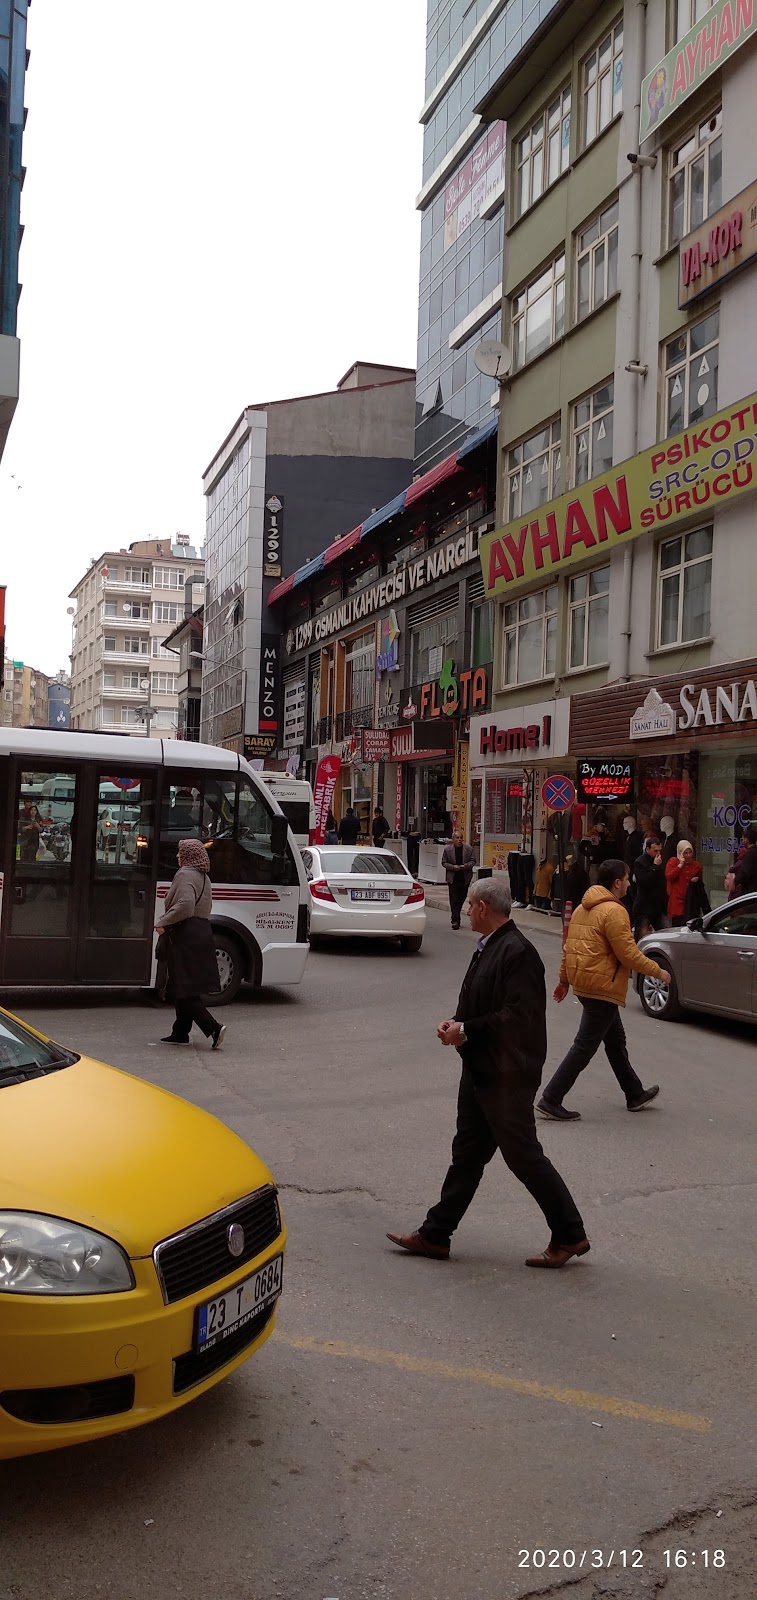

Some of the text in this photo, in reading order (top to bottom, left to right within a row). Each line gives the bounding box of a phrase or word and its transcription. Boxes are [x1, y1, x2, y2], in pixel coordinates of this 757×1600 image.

[670, 0, 754, 105] AYHAN
[681, 210, 743, 287] VA-KOR
[651, 402, 757, 475] PSİKOT
[649, 436, 757, 500] SRC-OD
[640, 459, 754, 528] SÜRÜCÜ
[267, 515, 280, 563] 1299
[487, 474, 632, 590] AYHAN
[294, 620, 313, 653] 1299
[314, 602, 352, 642] OSMANLI
[352, 562, 406, 622] KAHVECİSİ
[408, 558, 425, 591] VE
[263, 647, 277, 718] MENZO
[244, 736, 276, 747] SARAY
[366, 740, 388, 748] ÇORAP
[479, 725, 540, 755] Home
[634, 721, 652, 732] SANAT
[581, 763, 631, 778] By MODA
[315, 782, 325, 828] OSMANLI
[701, 837, 724, 853] HALI
[208, 1298, 226, 1335] 23
[236, 1286, 244, 1316] T
[254, 1260, 280, 1302] 0684
[239, 1303, 265, 1328] KAPORTA
[200, 1327, 207, 1337] TR
